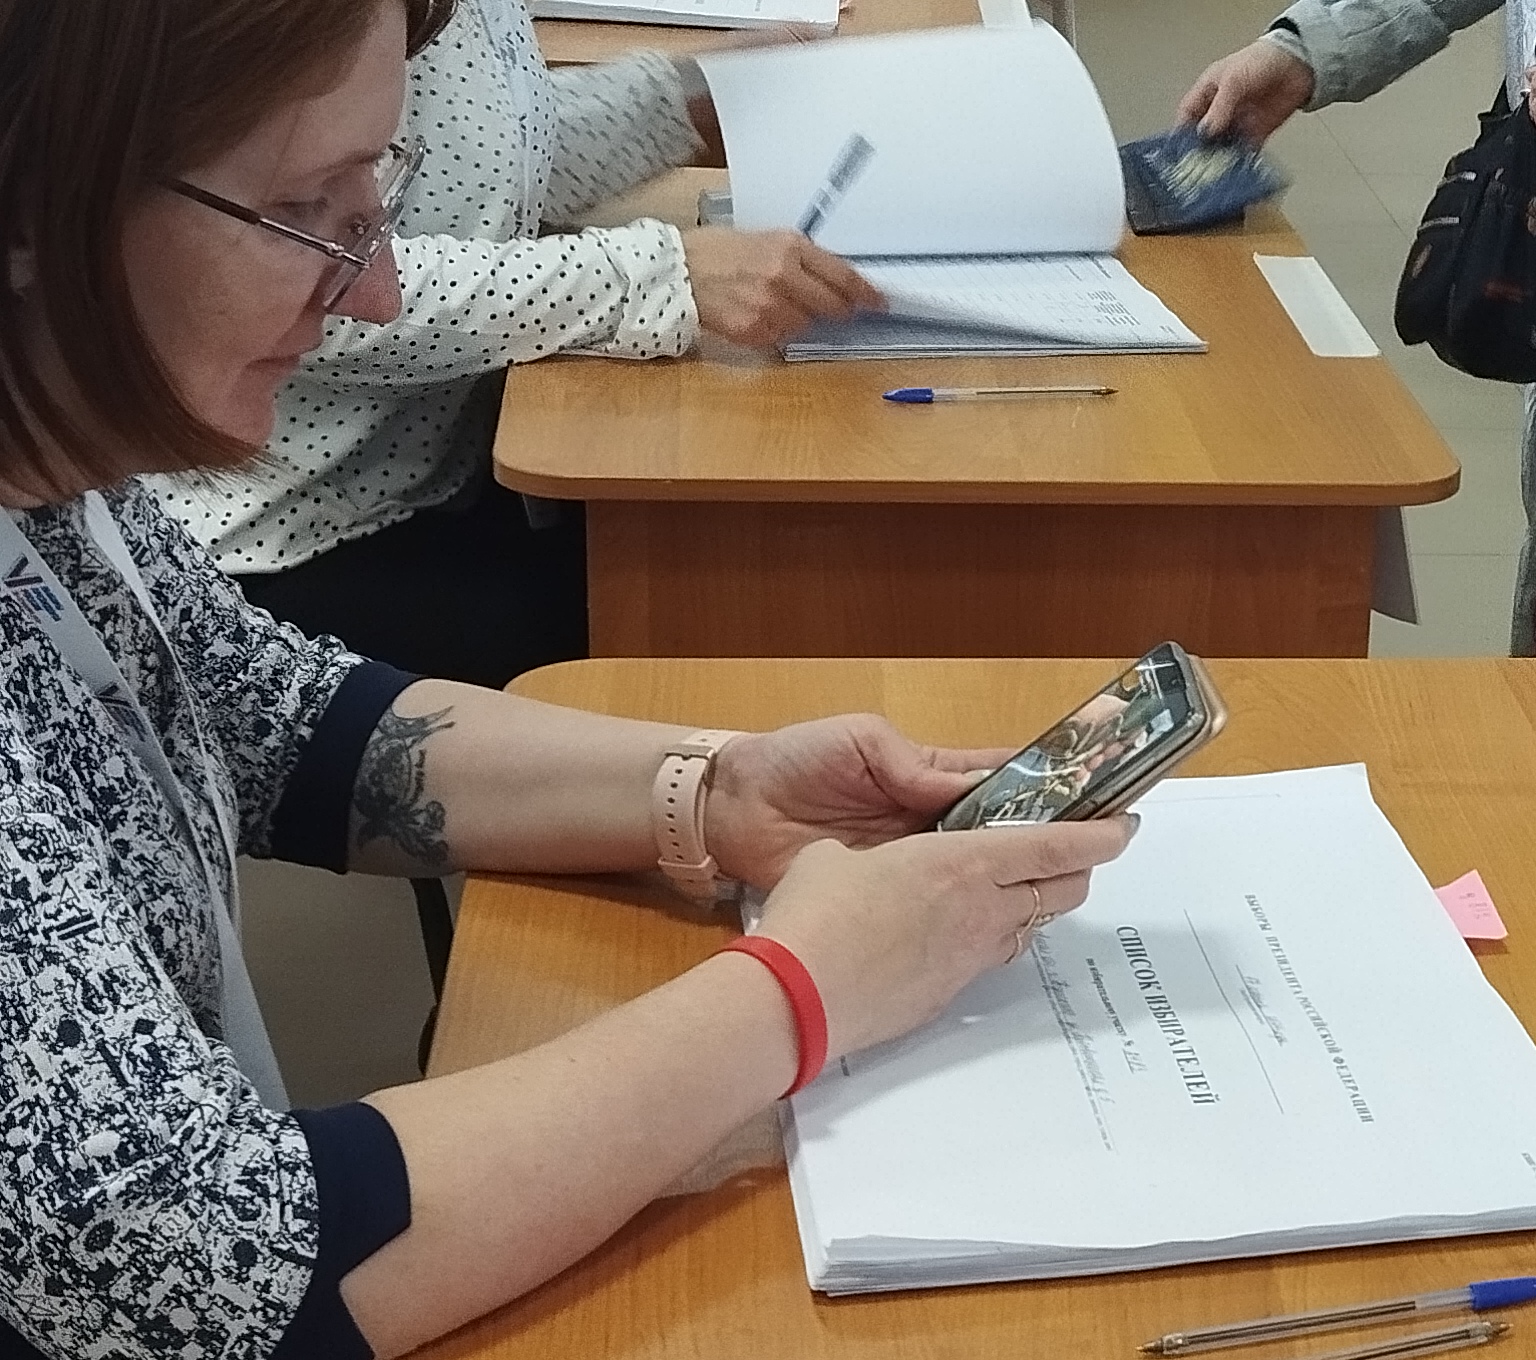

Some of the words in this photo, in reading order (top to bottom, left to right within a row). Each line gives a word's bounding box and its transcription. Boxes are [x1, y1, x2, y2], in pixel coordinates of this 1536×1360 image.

[1115, 925, 1163, 991] СПИСОК
[1144, 993, 1221, 1105] ИЗБИРАТЕЛЕЙ
[1244, 894, 1273, 932] ВЫБОРЫ
[1264, 935, 1304, 1000] ПРЕЗИДЕНТА
[1298, 995, 1344, 1055] РОССИЙСКОЙ
[1332, 1055, 1375, 1124] ФЕДЕРАЦИИ
